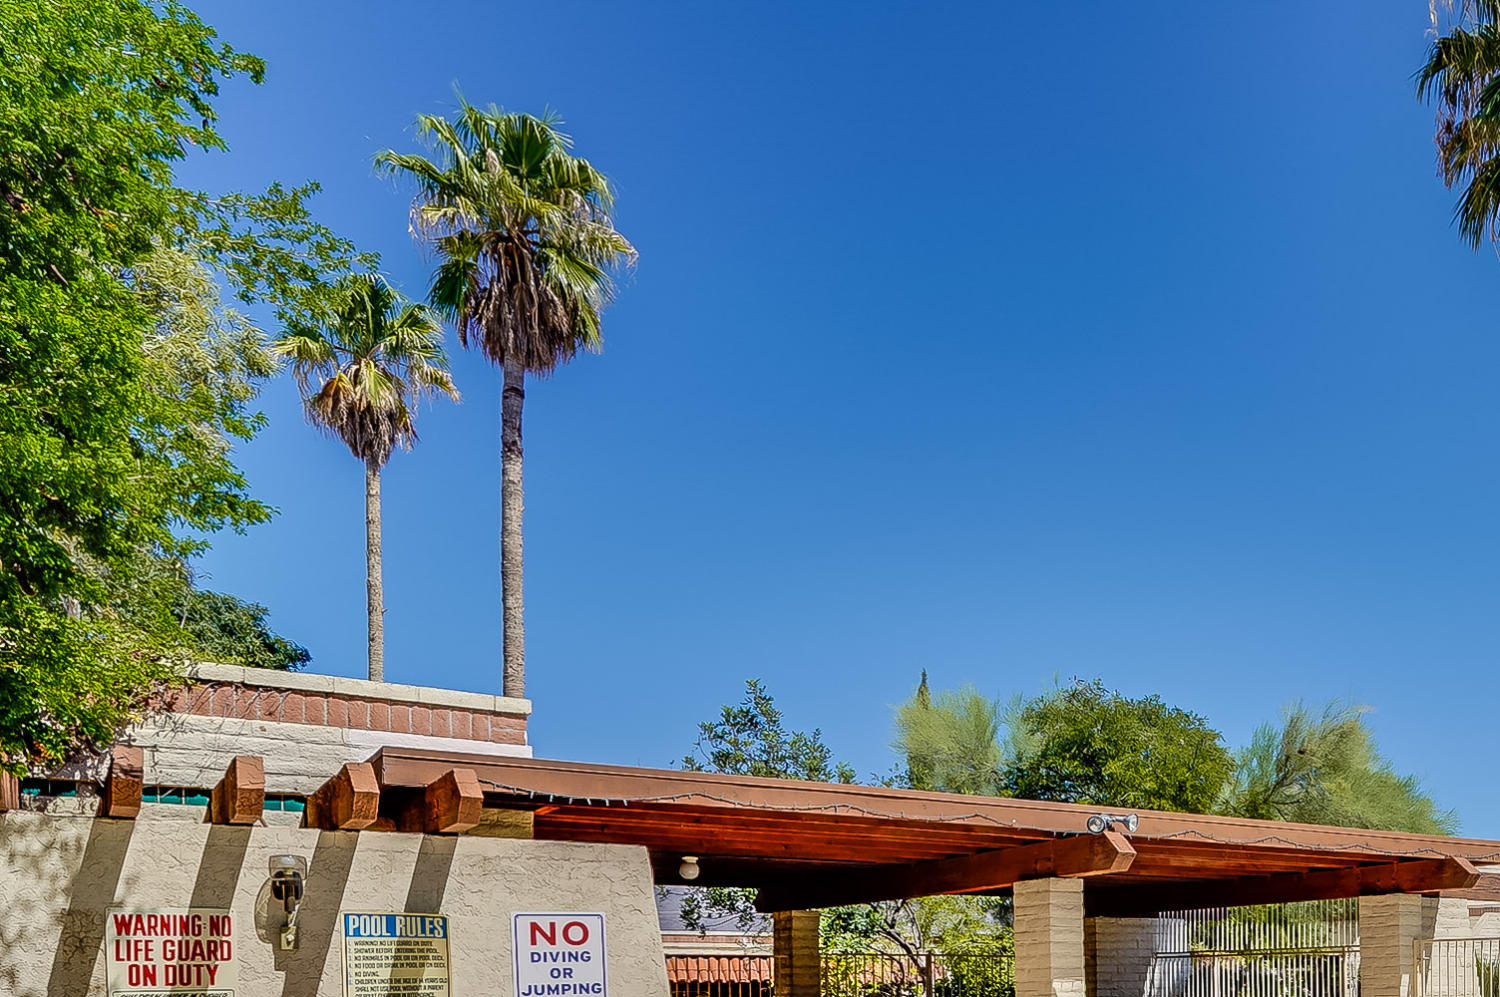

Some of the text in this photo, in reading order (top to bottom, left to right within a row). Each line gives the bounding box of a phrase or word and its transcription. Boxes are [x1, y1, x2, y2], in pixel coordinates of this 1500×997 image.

[209, 914, 232, 937] NO
[348, 915, 444, 938] POOL RULES
[530, 921, 589, 946] NO
[114, 939, 232, 961] LIFE GUARD
[530, 951, 591, 962] DIVING
[128, 964, 219, 986] ON DUTY
[550, 967, 573, 979] OR
[521, 983, 602, 996] JUMPING
